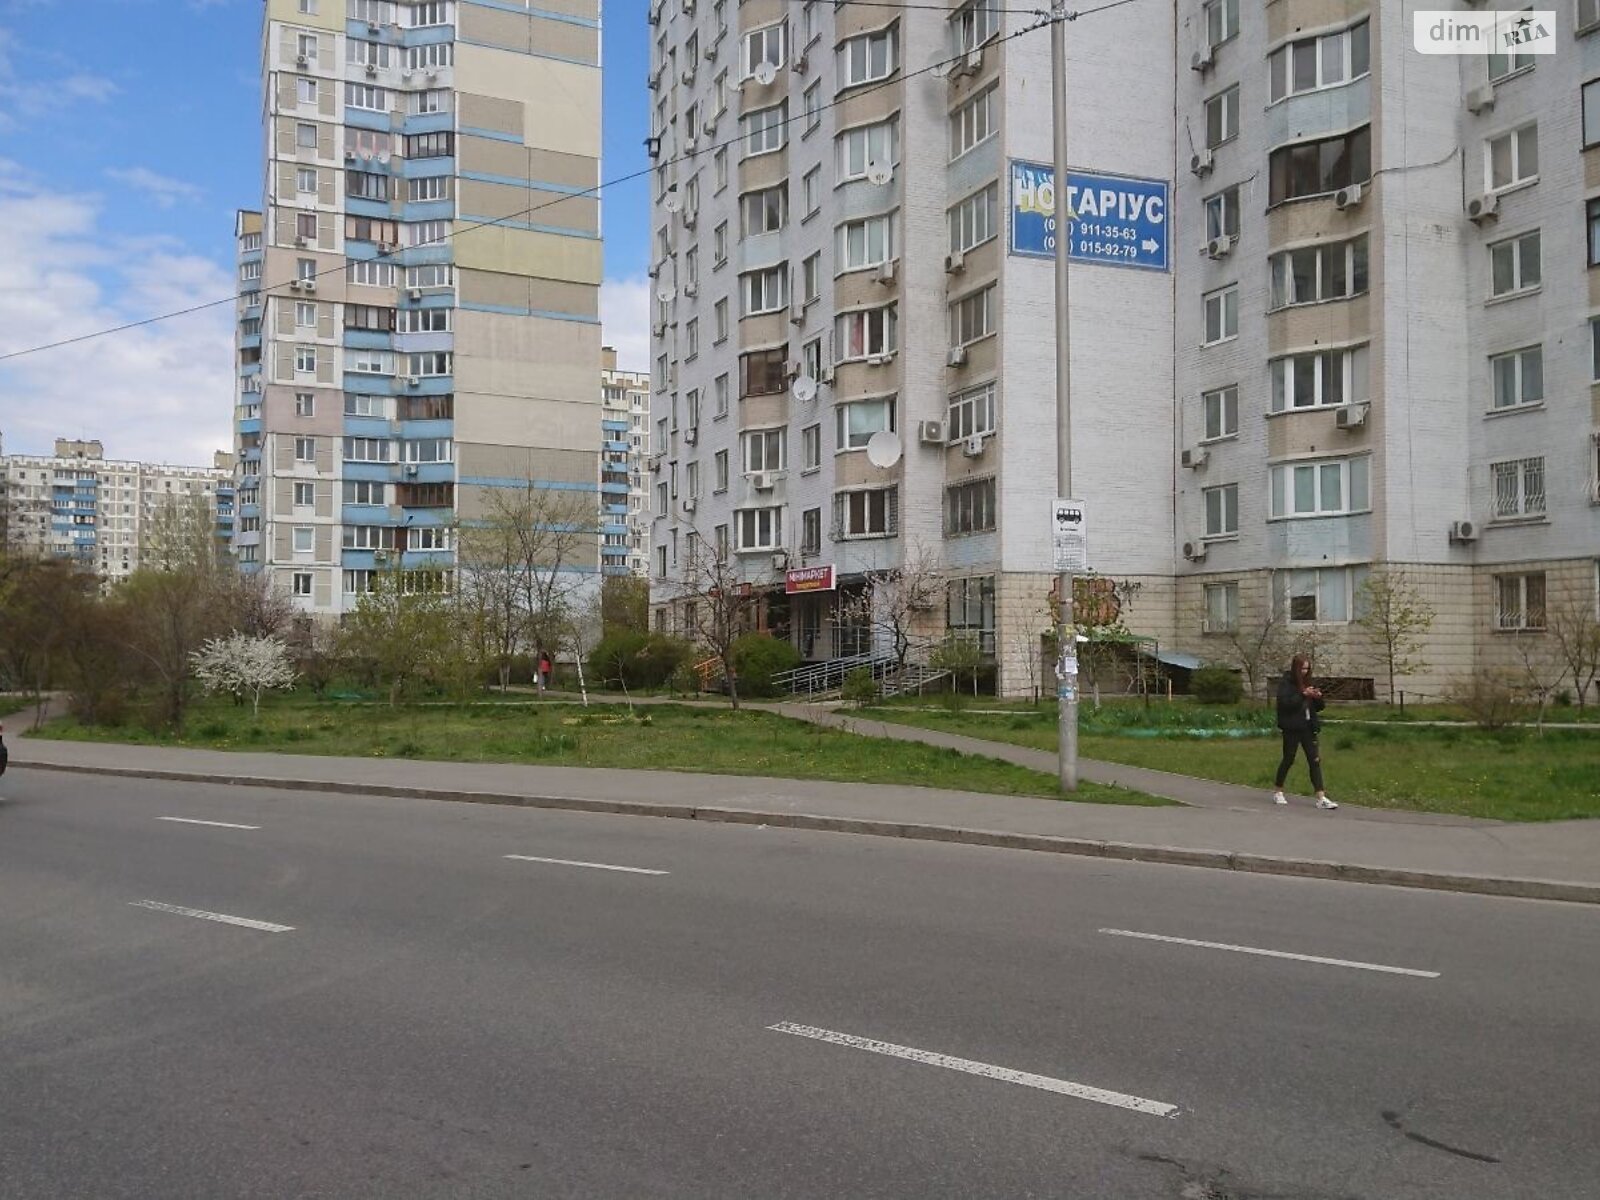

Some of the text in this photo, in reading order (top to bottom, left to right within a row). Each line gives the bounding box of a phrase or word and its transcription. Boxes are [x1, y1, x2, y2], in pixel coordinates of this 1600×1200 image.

[1015, 178, 1163, 224] НОТАРІУС
[1081, 223, 1136, 240] 911-35-63
[1080, 239, 1137, 257] 015-92-79
